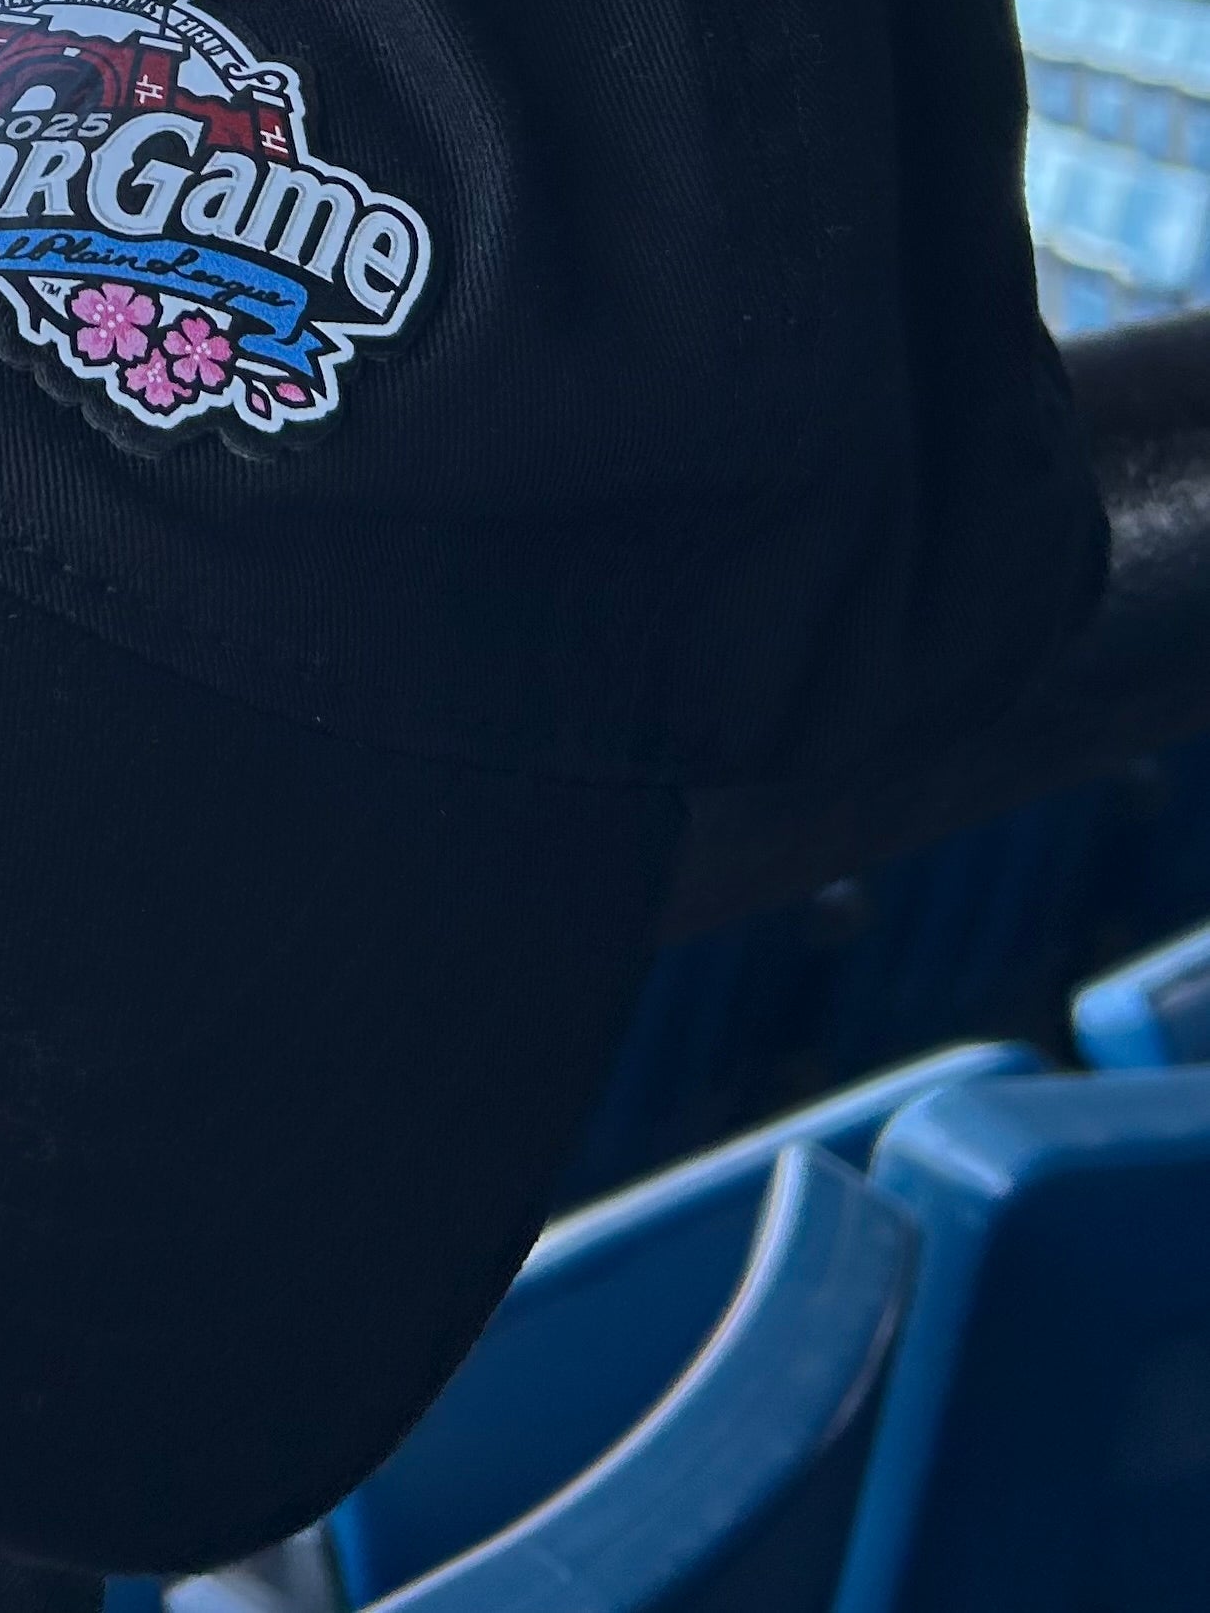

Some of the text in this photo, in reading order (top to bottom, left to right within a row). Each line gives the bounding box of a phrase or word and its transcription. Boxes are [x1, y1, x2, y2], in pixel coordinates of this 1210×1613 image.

[176, 14, 226, 57] FIELD
[86, 111, 411, 318] Game
[27, 233, 142, 273] Plain
[146, 248, 296, 305] League
